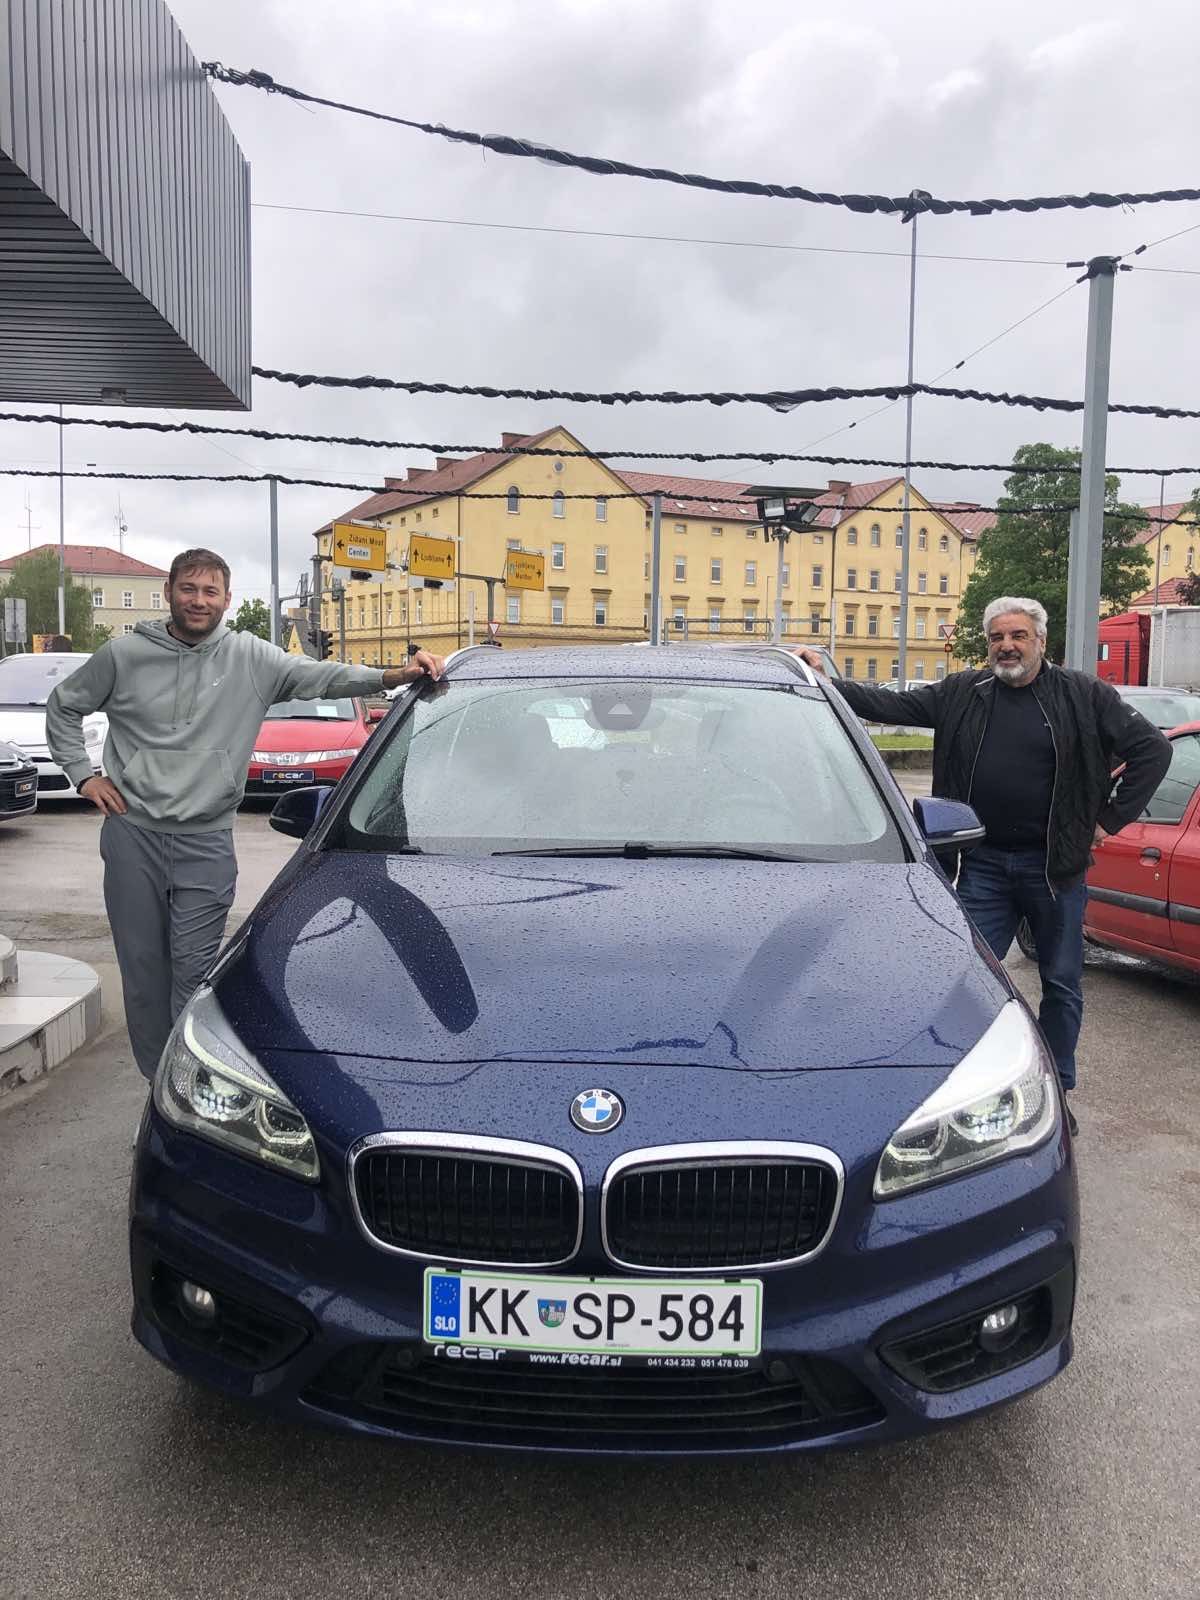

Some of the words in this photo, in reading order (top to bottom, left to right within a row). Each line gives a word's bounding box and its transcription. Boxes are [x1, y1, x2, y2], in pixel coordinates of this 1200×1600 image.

[576, 1089, 618, 1104] BMW
[468, 1286, 531, 1337] KK
[572, 1292, 745, 1342] SP-584
[434, 1315, 457, 1332] SLO
[433, 1344, 507, 1361] recar
[647, 1358, 662, 1367] 041
[664, 1358, 679, 1367] 434
[681, 1358, 696, 1368] 232
[701, 1359, 715, 1368] 051
